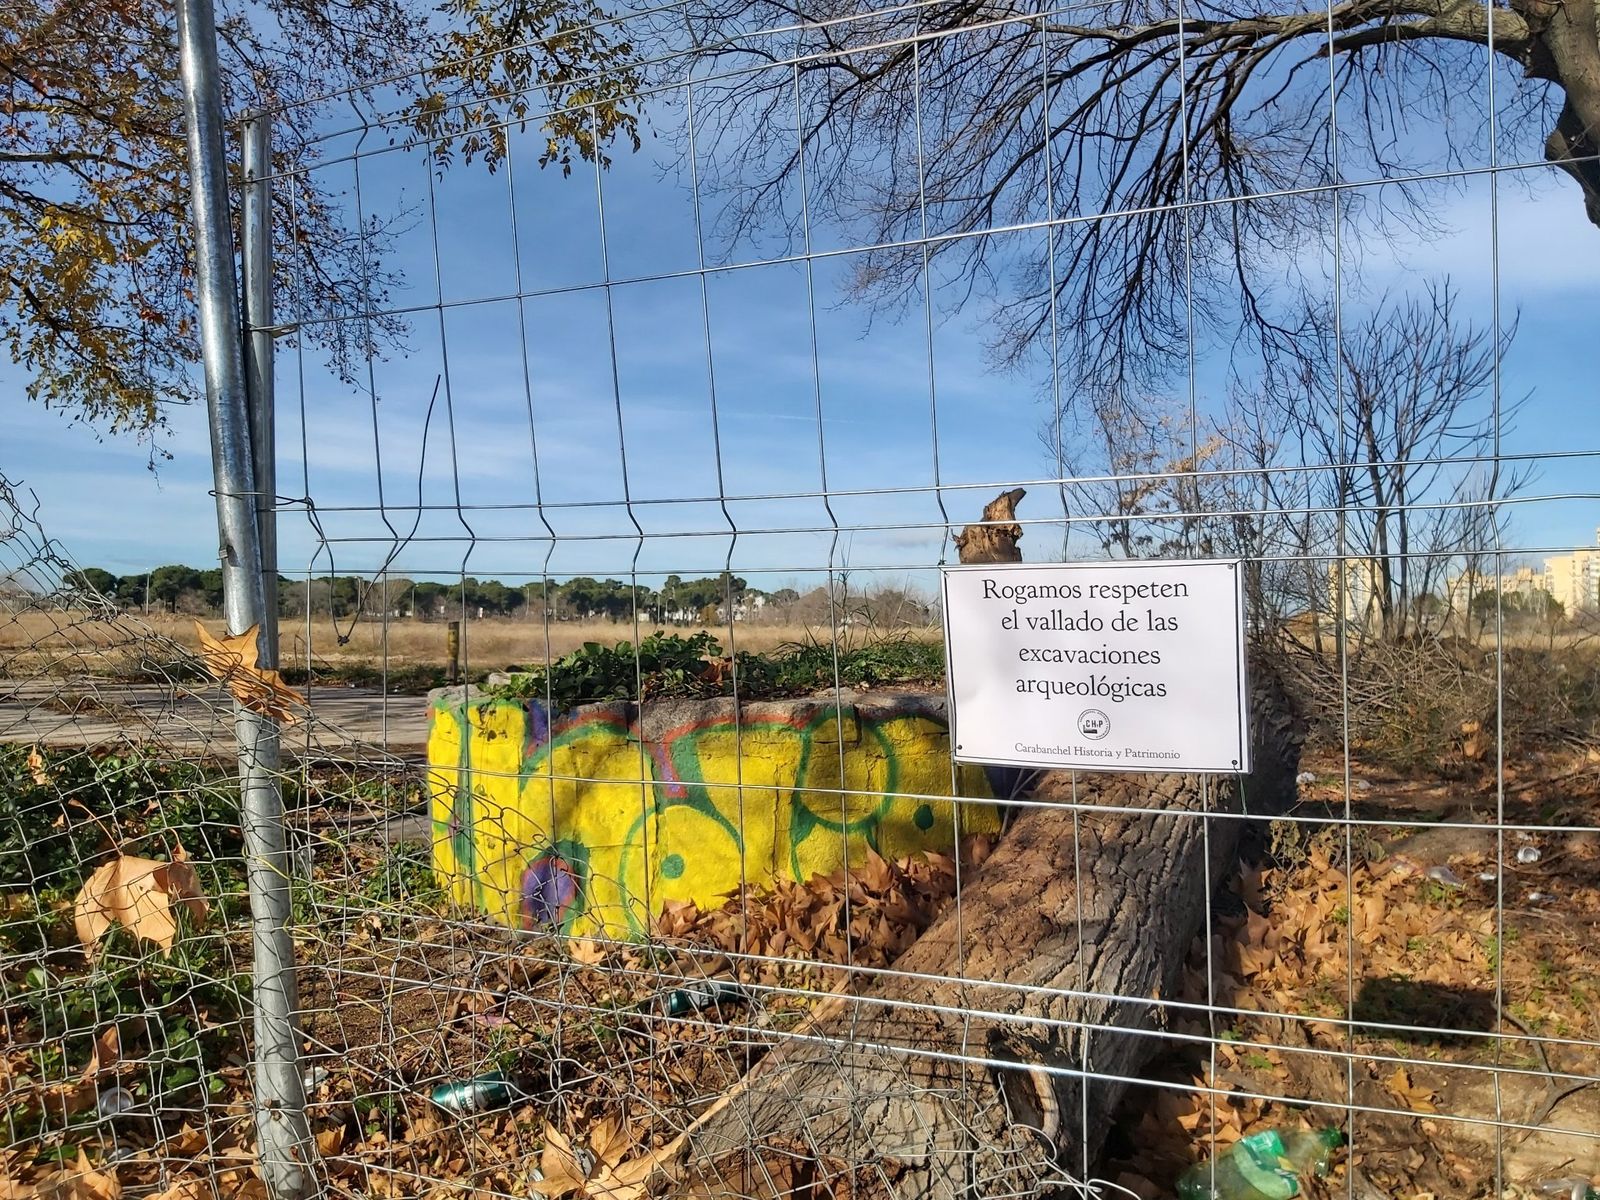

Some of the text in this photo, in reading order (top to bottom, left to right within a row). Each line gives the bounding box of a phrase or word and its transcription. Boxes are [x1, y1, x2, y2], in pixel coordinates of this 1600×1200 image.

[982, 579, 1189, 604] Rogamos respeten
[1001, 609, 1179, 632] el vallado de las
[1018, 644, 1161, 665] excavaciones
[1016, 675, 1167, 702] arqueológicas
[1014, 742, 1181, 760] Carabanchel Historia y Patrimonio
